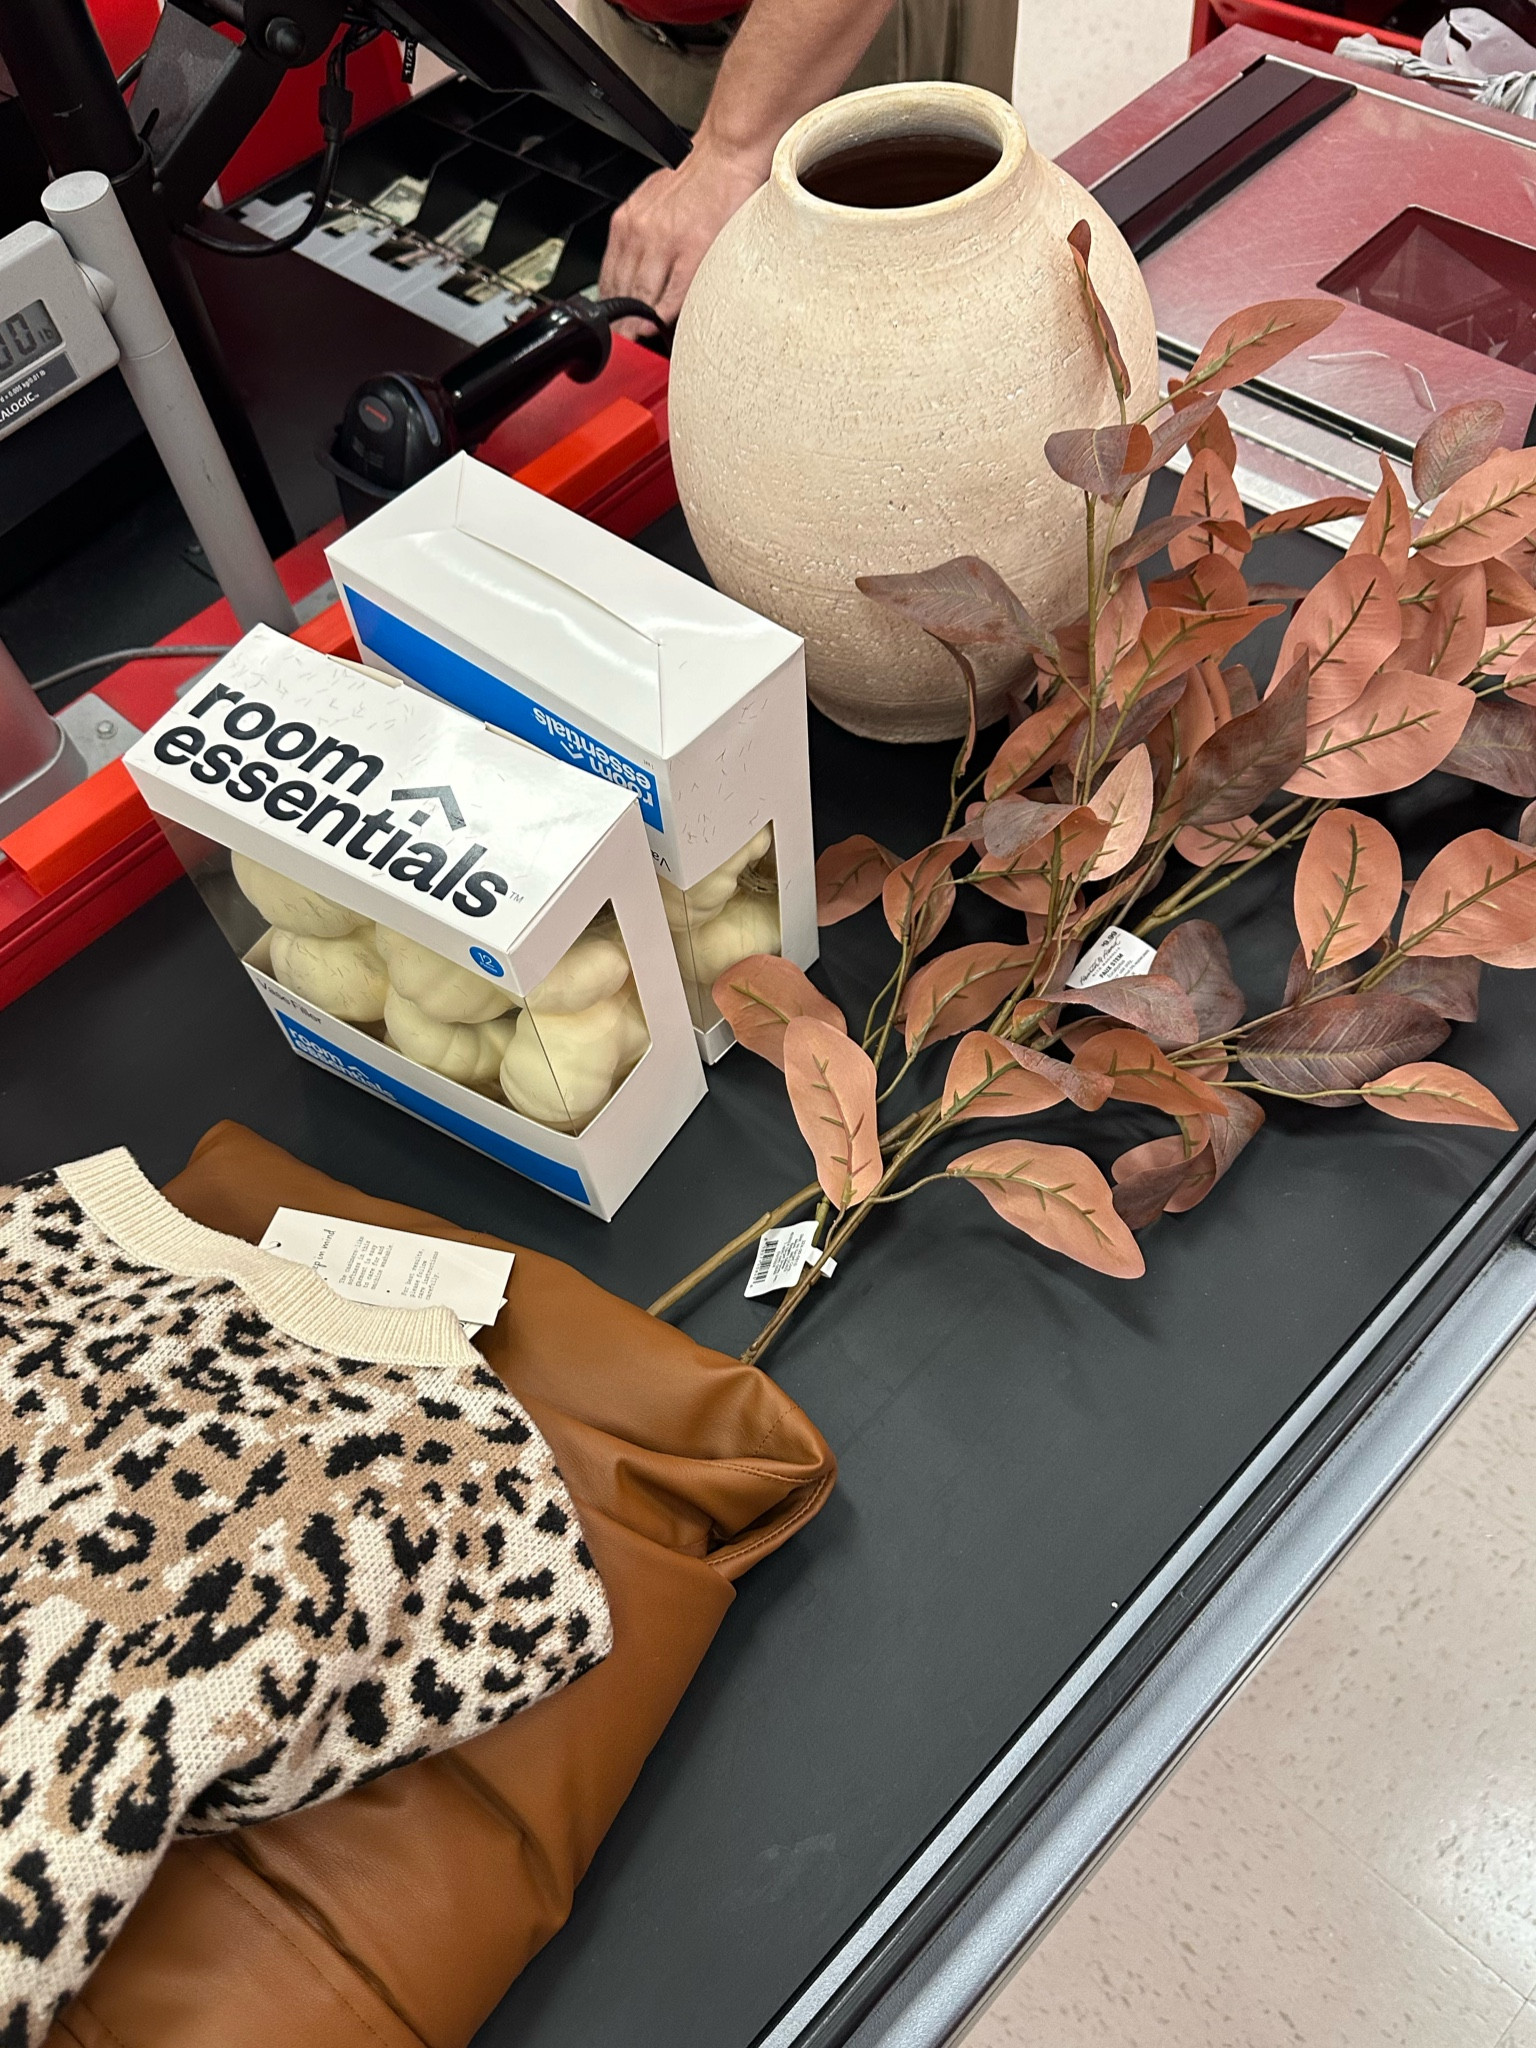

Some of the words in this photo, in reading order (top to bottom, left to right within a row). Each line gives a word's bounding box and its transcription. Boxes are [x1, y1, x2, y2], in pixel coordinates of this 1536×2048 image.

[0, 391, 35, 422] ALOGIC
[188, 682, 384, 797] room
[532, 707, 652, 790] essentials
[153, 725, 509, 918] essentials
[651, 849, 671, 873] Va
[478, 952, 495, 968] 12
[1099, 965, 1112, 979] FAUX
[1112, 952, 1124, 967] STEM
[288, 1027, 344, 1067] room
[294, 1039, 397, 1101] essentials
[322, 1228, 336, 1249] mind
